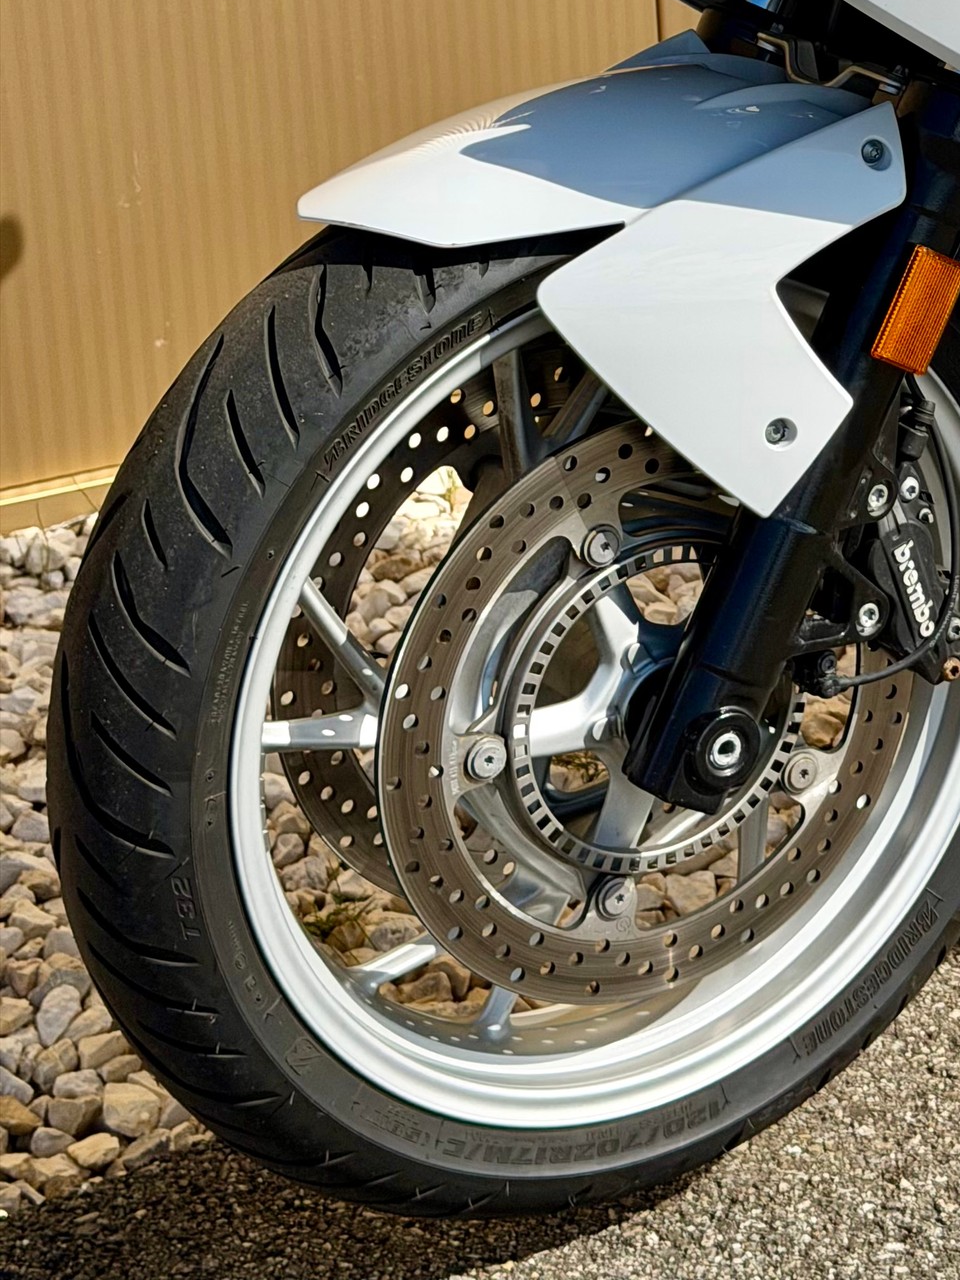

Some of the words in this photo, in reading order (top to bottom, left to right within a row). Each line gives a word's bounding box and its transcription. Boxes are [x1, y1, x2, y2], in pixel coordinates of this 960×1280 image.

[324, 311, 483, 470] BRIDGESTONE
[893, 537, 935, 638] brembo
[171, 877, 202, 942] T32
[802, 899, 939, 1056] BRIDGESTONE
